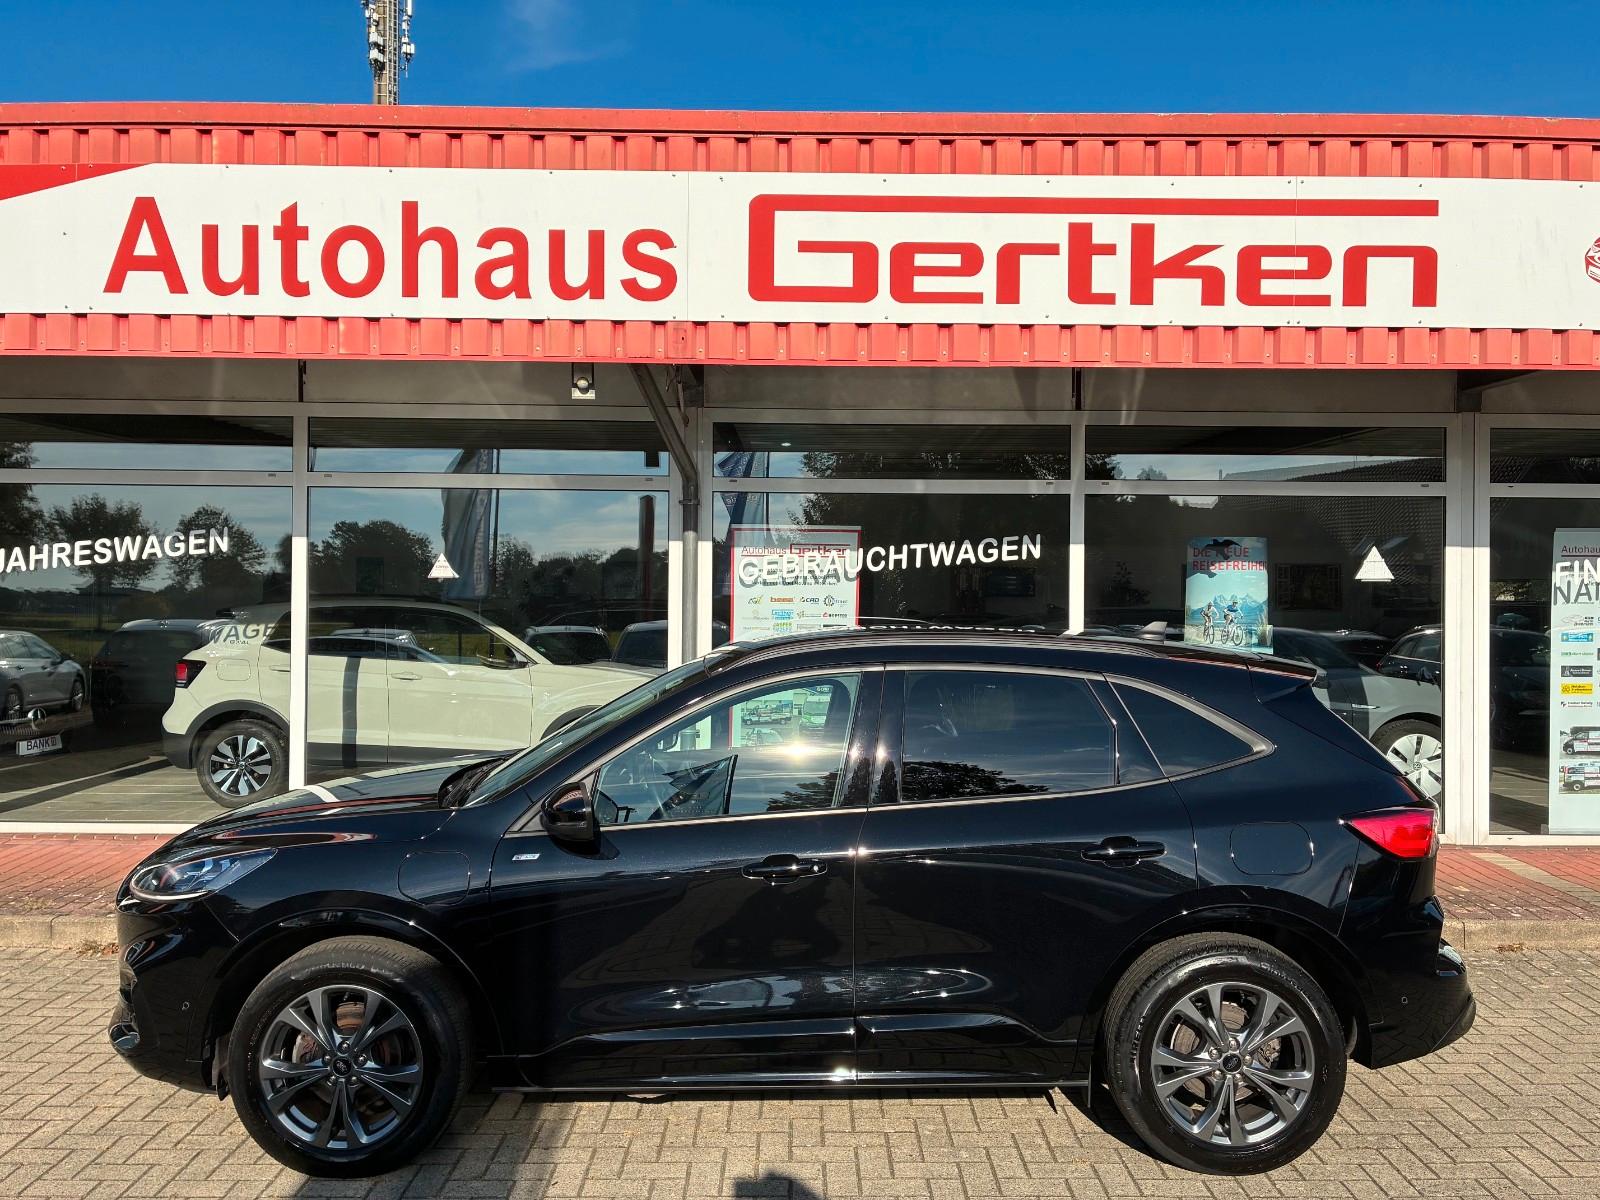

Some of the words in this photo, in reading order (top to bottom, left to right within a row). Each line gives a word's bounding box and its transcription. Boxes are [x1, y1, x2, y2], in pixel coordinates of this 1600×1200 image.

[103, 196, 679, 302] Autohaus
[748, 193, 1440, 308] Gertken
[738, 533, 1041, 585] GEBRAUCHTWAGEN
[741, 545, 787, 555] Autohaus
[26, 736, 50, 751] BANK
